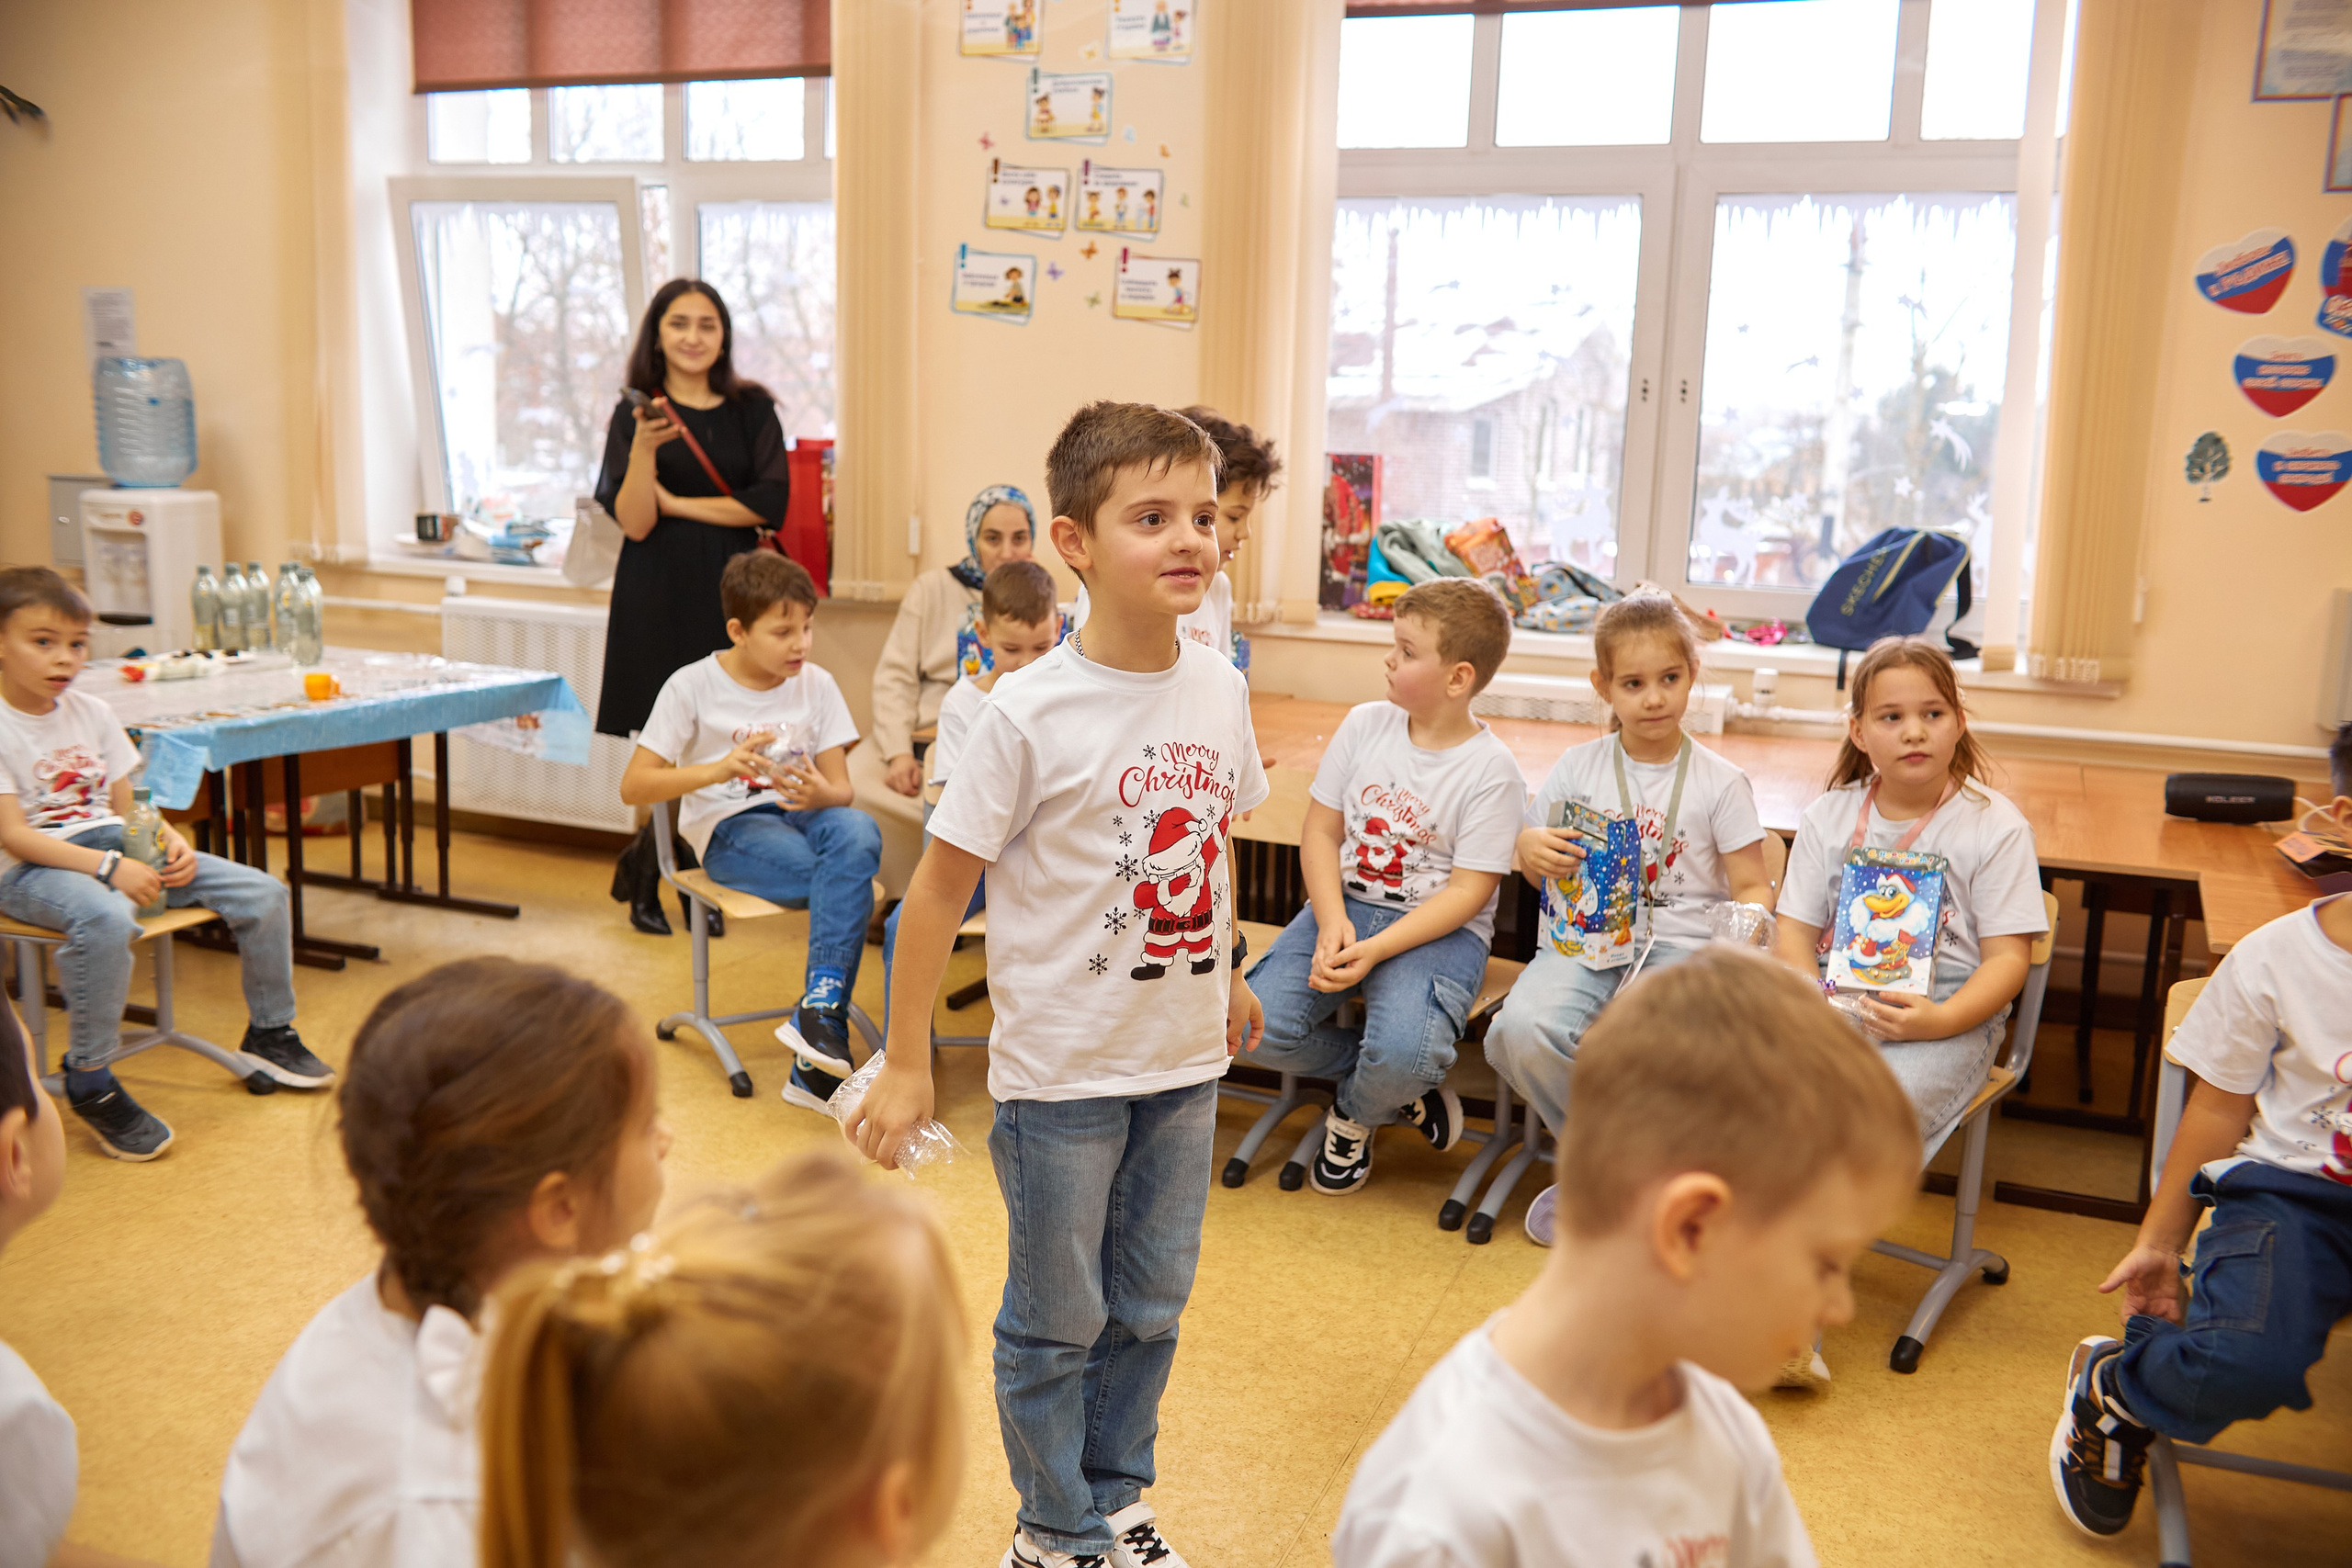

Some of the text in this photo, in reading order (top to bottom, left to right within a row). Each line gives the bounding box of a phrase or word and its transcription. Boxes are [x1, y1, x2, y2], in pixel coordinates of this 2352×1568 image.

[1160, 741, 1219, 771] Merry
[1361, 784, 1437, 845] Christmas
[1395, 787, 1430, 817] Merry
